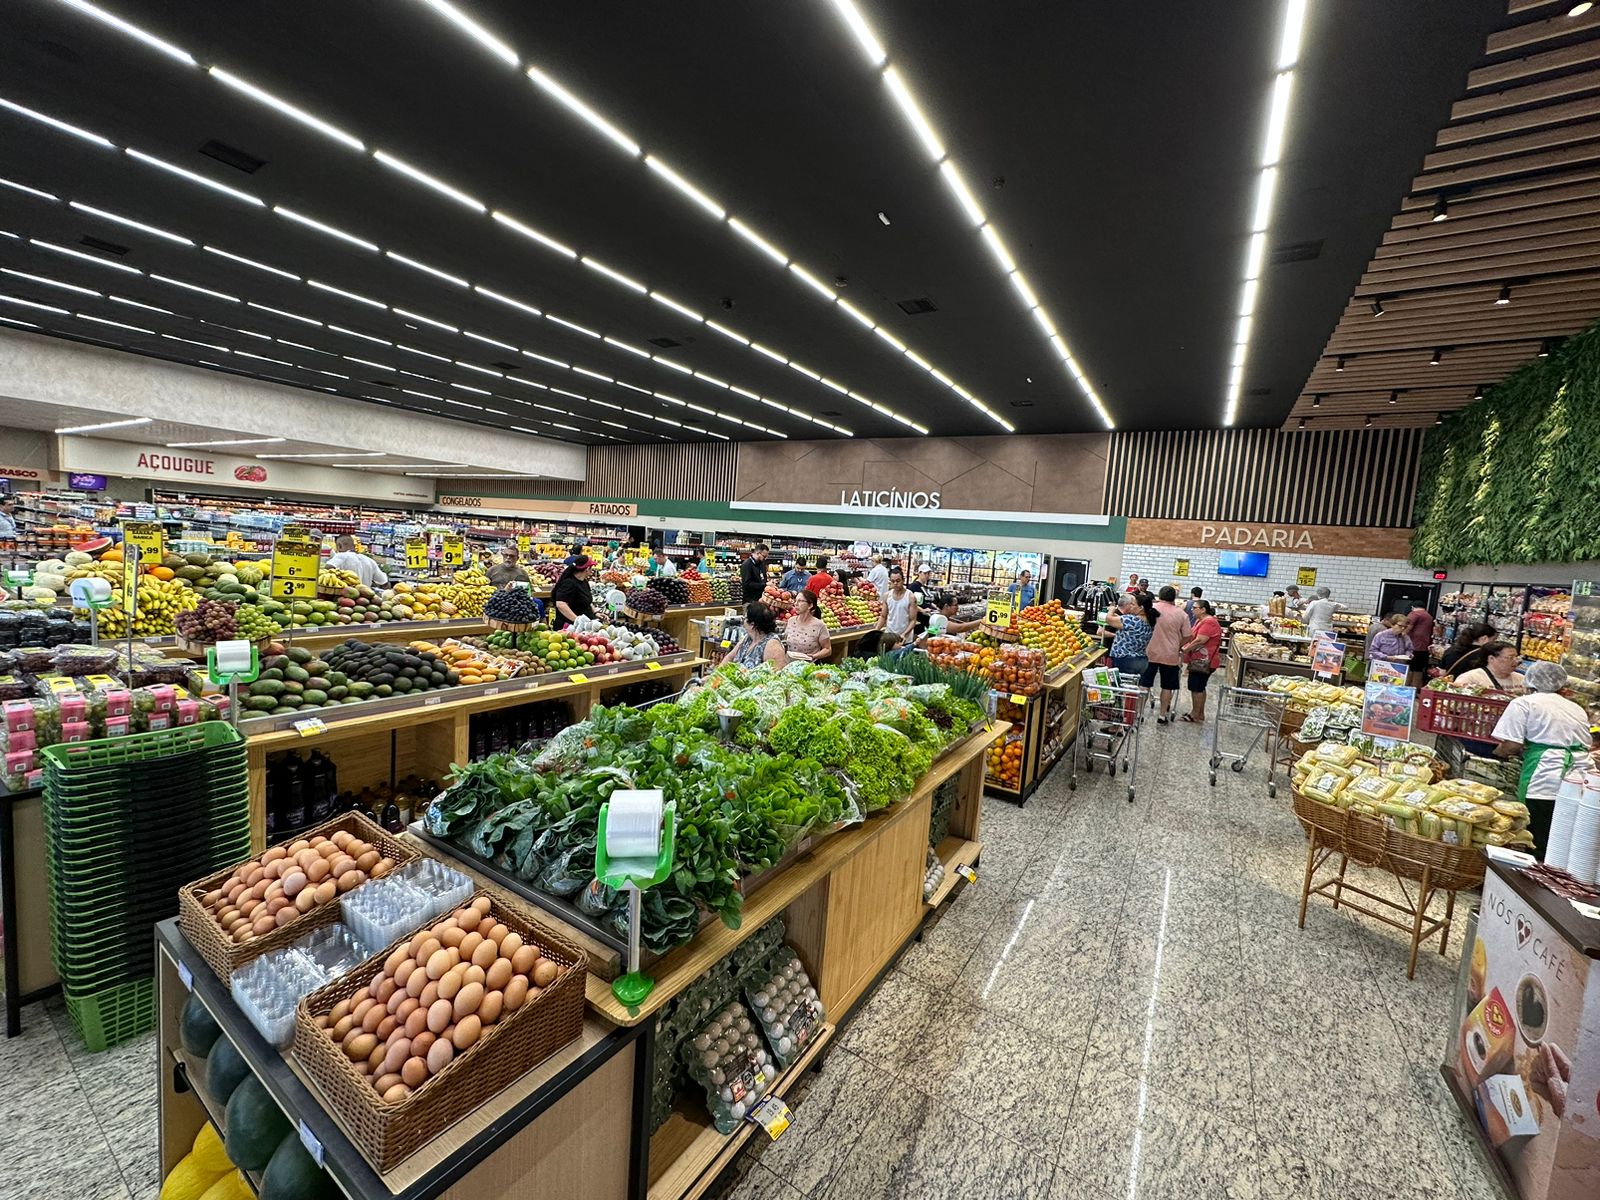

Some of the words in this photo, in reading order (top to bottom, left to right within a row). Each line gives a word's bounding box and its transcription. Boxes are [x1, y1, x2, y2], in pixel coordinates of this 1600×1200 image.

[137, 452, 214, 474] AÇOUGUE
[442, 496, 482, 507] CONGELADOS
[841, 487, 940, 509] LATICÍNIOS
[590, 503, 631, 516] FATIADOS
[1200, 525, 1313, 549] PADARIA
[283, 581, 305, 595] 3,99
[989, 610, 1008, 623] 6,99
[1488, 893, 1513, 925] NÓS
[1532, 938, 1566, 981] CAFÉ
